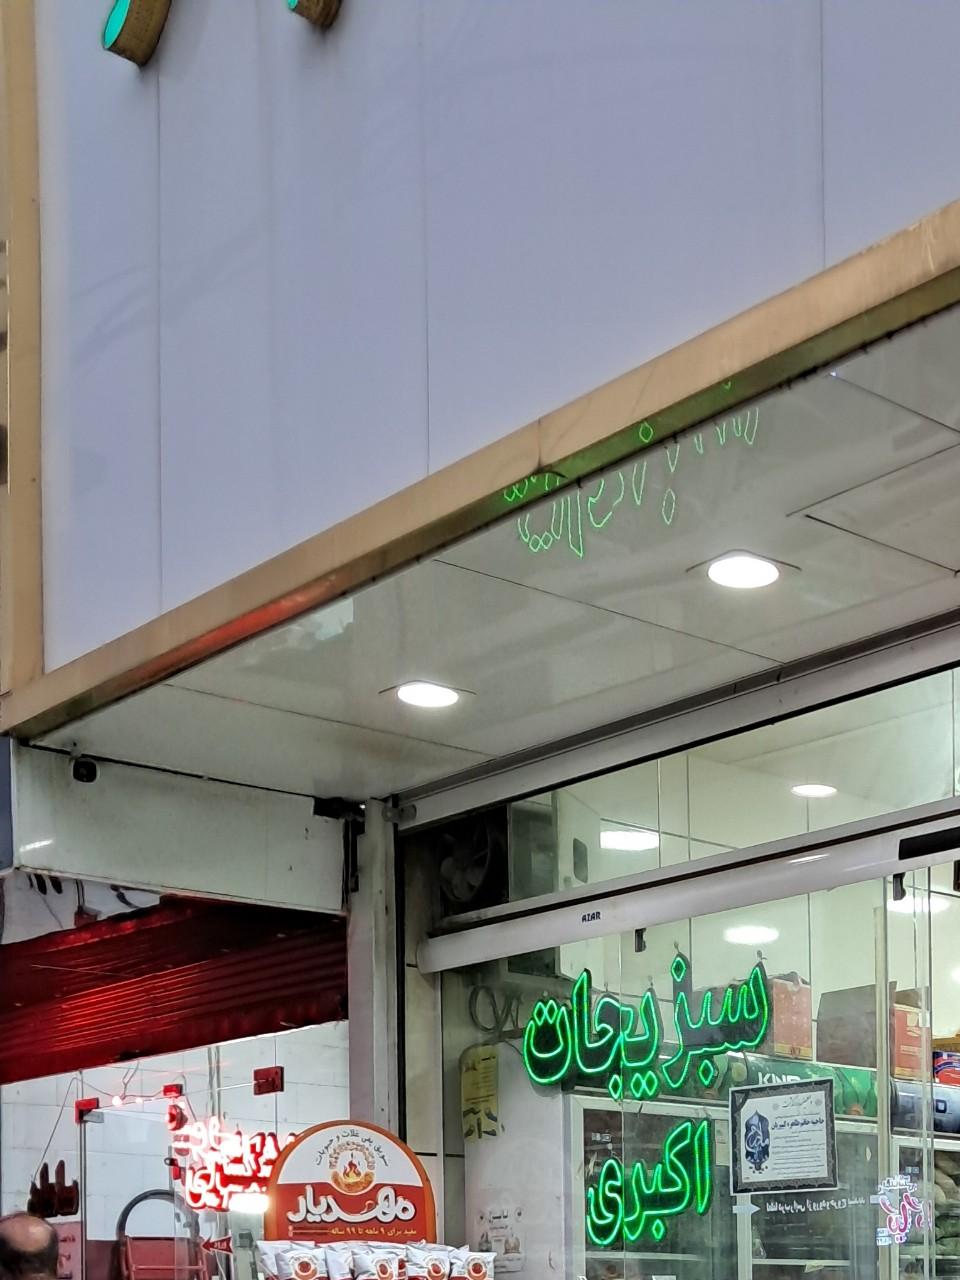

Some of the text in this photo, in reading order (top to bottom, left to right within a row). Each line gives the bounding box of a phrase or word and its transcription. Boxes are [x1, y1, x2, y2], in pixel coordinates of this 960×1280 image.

[523, 956, 770, 1100] سبزیجات
[287, 1184, 416, 1224] مهدیار
[586, 1118, 714, 1246] اکبری
